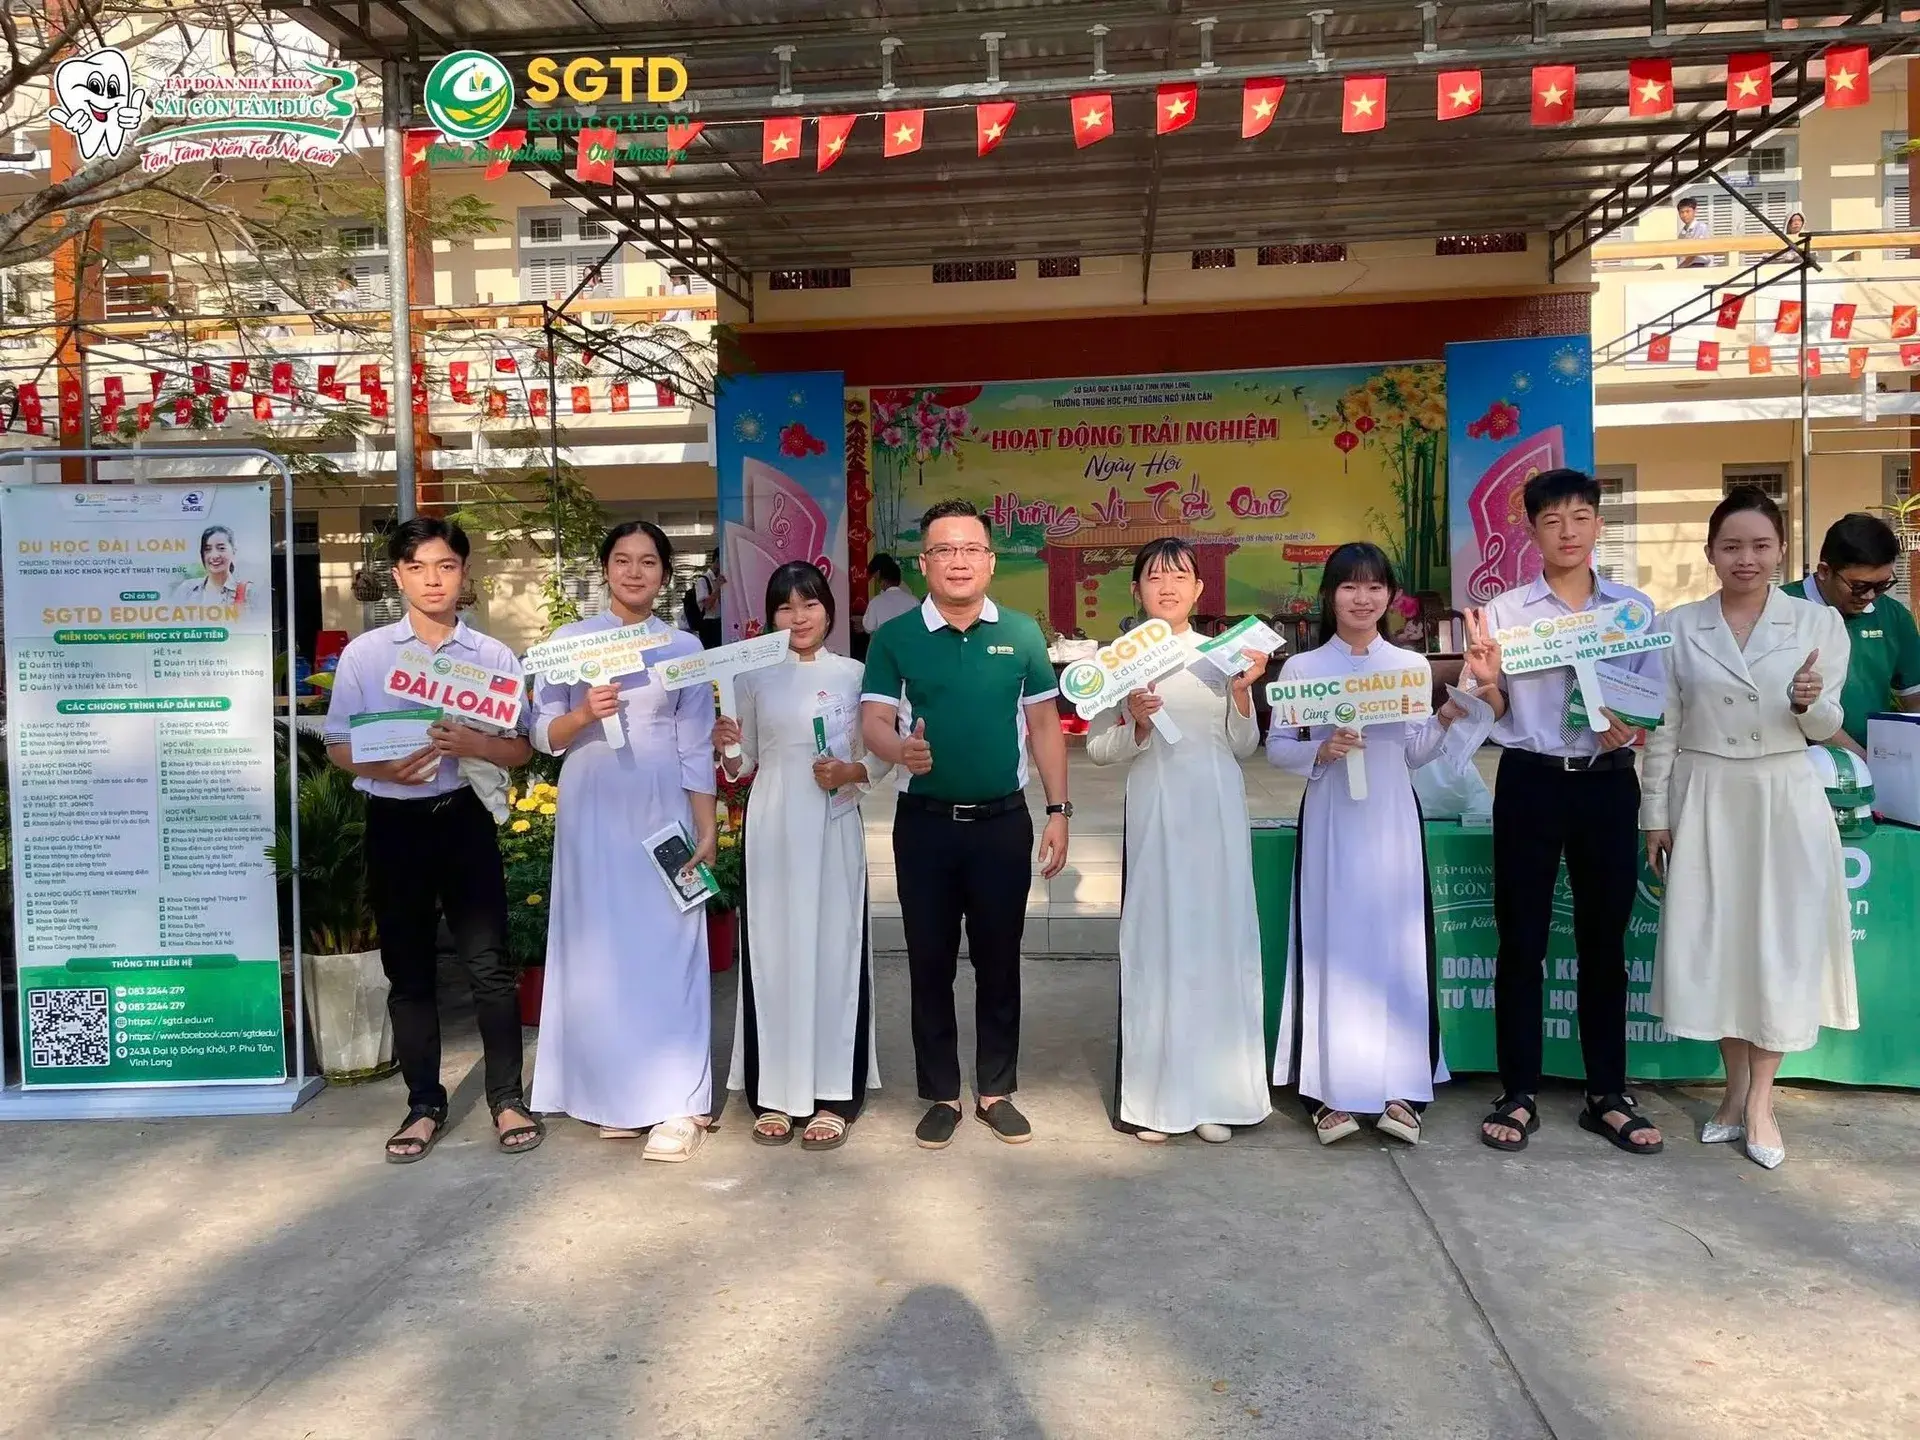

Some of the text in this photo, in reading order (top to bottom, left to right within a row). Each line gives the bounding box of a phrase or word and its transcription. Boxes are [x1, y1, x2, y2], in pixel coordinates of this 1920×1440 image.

[992, 413, 1279, 453] HOẠT ĐỘNG TRẢI NGHIỆM
[1084, 450, 1183, 482] Ngày Hội
[1091, 486, 1131, 529] Vị
[1143, 473, 1215, 522] Tết
[1226, 486, 1288, 518] Quê
[19, 537, 187, 557] DU HỌC ĐÀI LOAN
[42, 604, 240, 625] SGTD EDUCATION
[1556, 614, 1595, 629] SGTD
[83, 632, 106, 641] 100%
[108, 632, 129, 642] HỌC
[131, 630, 145, 640] PHÍ
[147, 631, 167, 642] HỌC
[531, 647, 550, 658] HỘI
[552, 642, 579, 655] NHẬP
[580, 635, 608, 648] TOÀN
[1503, 631, 1598, 658] ANH ÚC MỸ
[1101, 624, 1167, 670] SGTD
[1506, 635, 1672, 671] CANADA NEW ZEALAND
[536, 656, 569, 669] THÀNH
[550, 653, 638, 681] Cùng SGTD
[1112, 639, 1179, 681] Education
[1100, 679, 1138, 707] Aspirations
[1271, 670, 1425, 701] DU HỌC CHÂU ÂU
[66, 702, 85, 711] CÁC
[88, 702, 127, 711] CHƯƠNG
[129, 700, 154, 710] TRÌNH
[197, 699, 222, 708] KHÁC
[390, 670, 516, 723] ĐÀI LOAN
[1302, 699, 1399, 723] Cùng SGTD
[1359, 712, 1400, 721] Education
[1436, 864, 1458, 876] TẬP
[1432, 879, 1487, 896] ÀI GÒN
[1442, 921, 1467, 933] Tâm
[1629, 916, 1659, 937] You
[112, 958, 193, 968] THÔNG TIN LIÊN HỆ
[1442, 954, 1497, 979] ĐOÀN
[169, 986, 185, 994] 279
[1440, 983, 1578, 1015] TƯ VẤ HỌ
[128, 1003, 145, 1011] 083
[170, 1002, 185, 1010] 279
[128, 1016, 214, 1027] https://sgtd.edu.vn
[1543, 1018, 1571, 1039] TD
[129, 1047, 150, 1055] 243A
[230, 1045, 237, 1053] P.
[239, 1044, 256, 1053] Phú
[130, 1058, 173, 1068] Vĩnh Long
